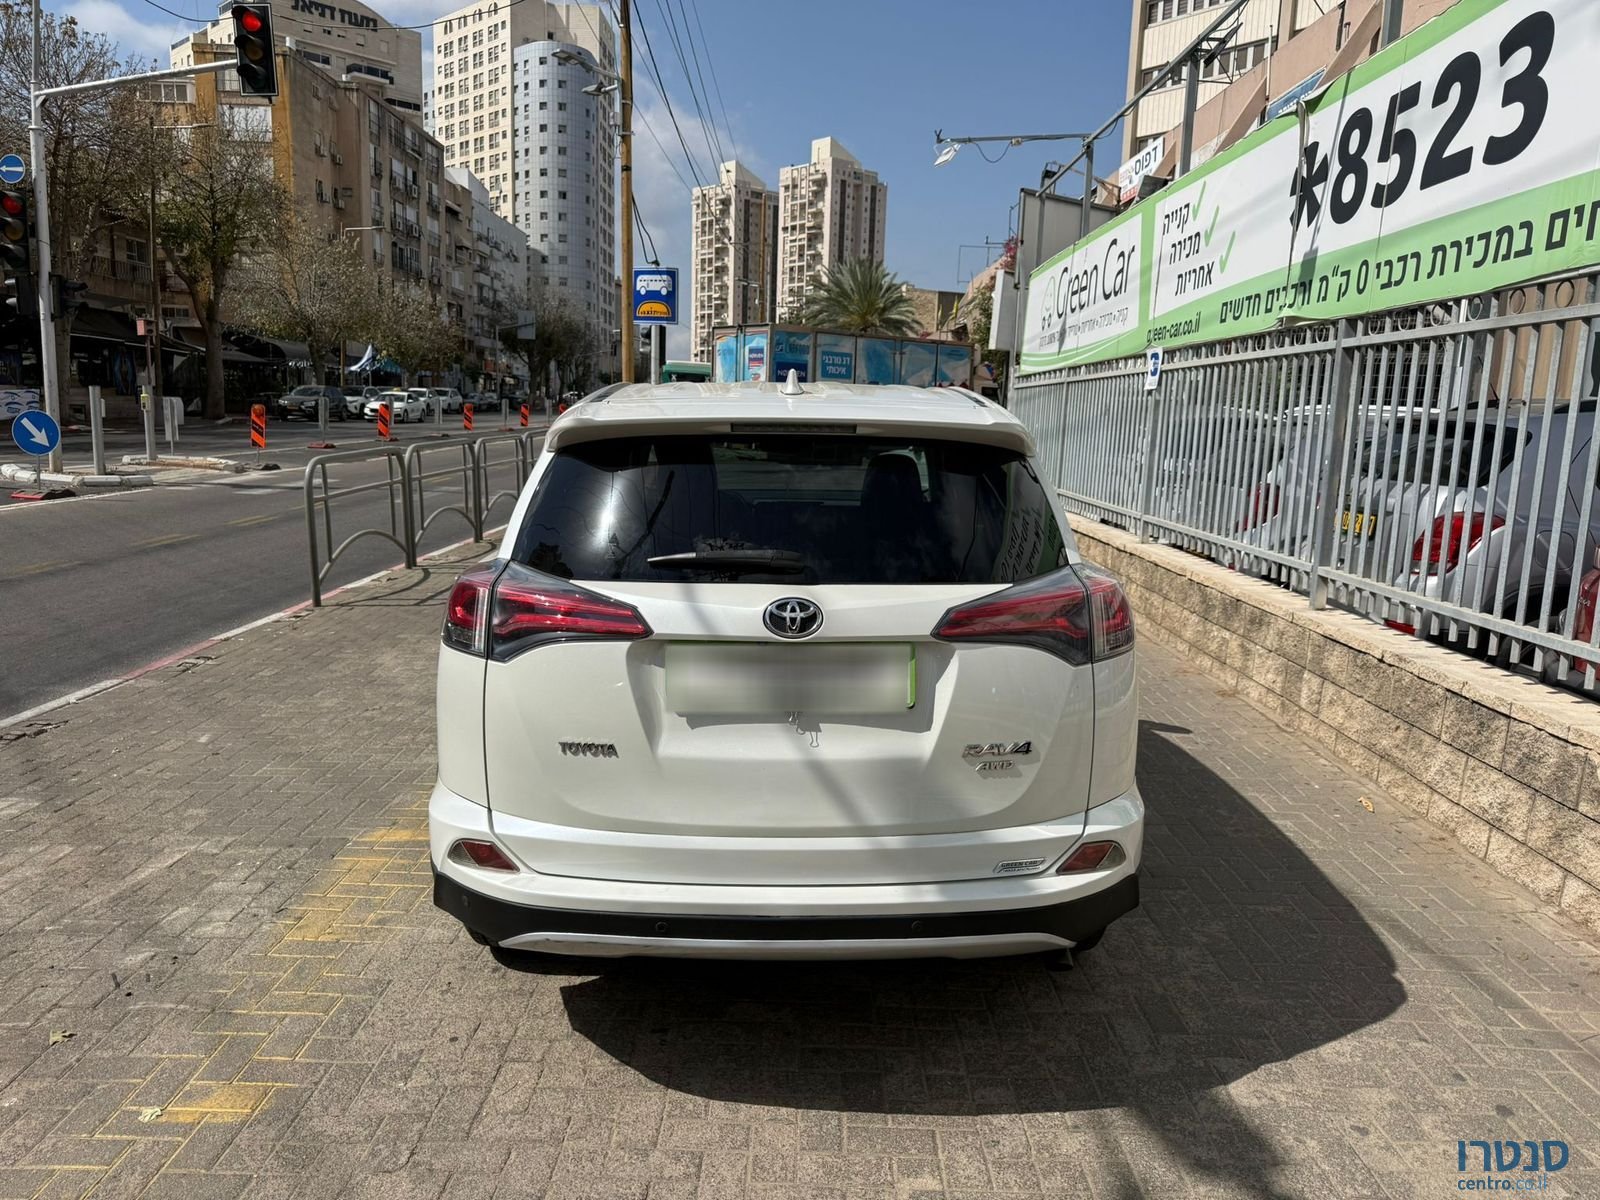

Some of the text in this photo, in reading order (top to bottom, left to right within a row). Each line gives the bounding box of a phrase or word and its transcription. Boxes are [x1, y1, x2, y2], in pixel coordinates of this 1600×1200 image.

[1134, 145, 1158, 176] דפוס
[1162, 202, 1191, 236] קנייה
[1168, 231, 1201, 265] מכירה
[1426, 220, 1534, 280] במכירת
[1056, 238, 1136, 319] Green Car
[1174, 261, 1215, 297] אחריות
[1356, 259, 1370, 296] 0
[1375, 251, 1422, 290] רכבי
[1219, 293, 1261, 324] חדשים
[558, 742, 619, 758] TOYOTA
[962, 741, 1032, 758] RAV4
[975, 760, 1016, 772] AWD
